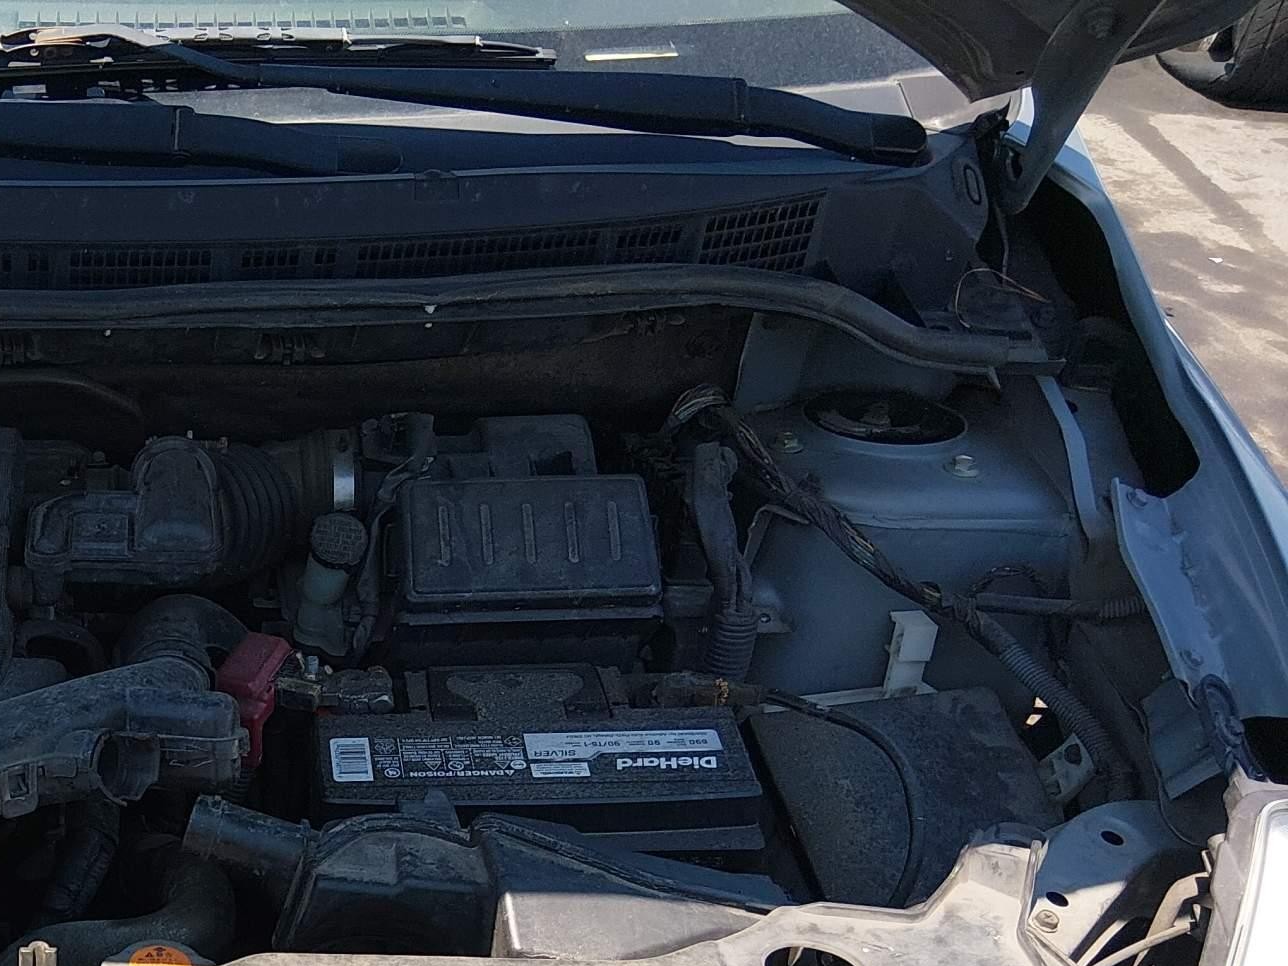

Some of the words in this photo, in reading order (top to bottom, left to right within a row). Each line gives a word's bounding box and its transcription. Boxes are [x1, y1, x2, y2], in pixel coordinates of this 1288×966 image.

[533, 749, 577, 758] SILVER
[616, 756, 717, 770] DieHard
[409, 769, 505, 778] DANGER/POISON
